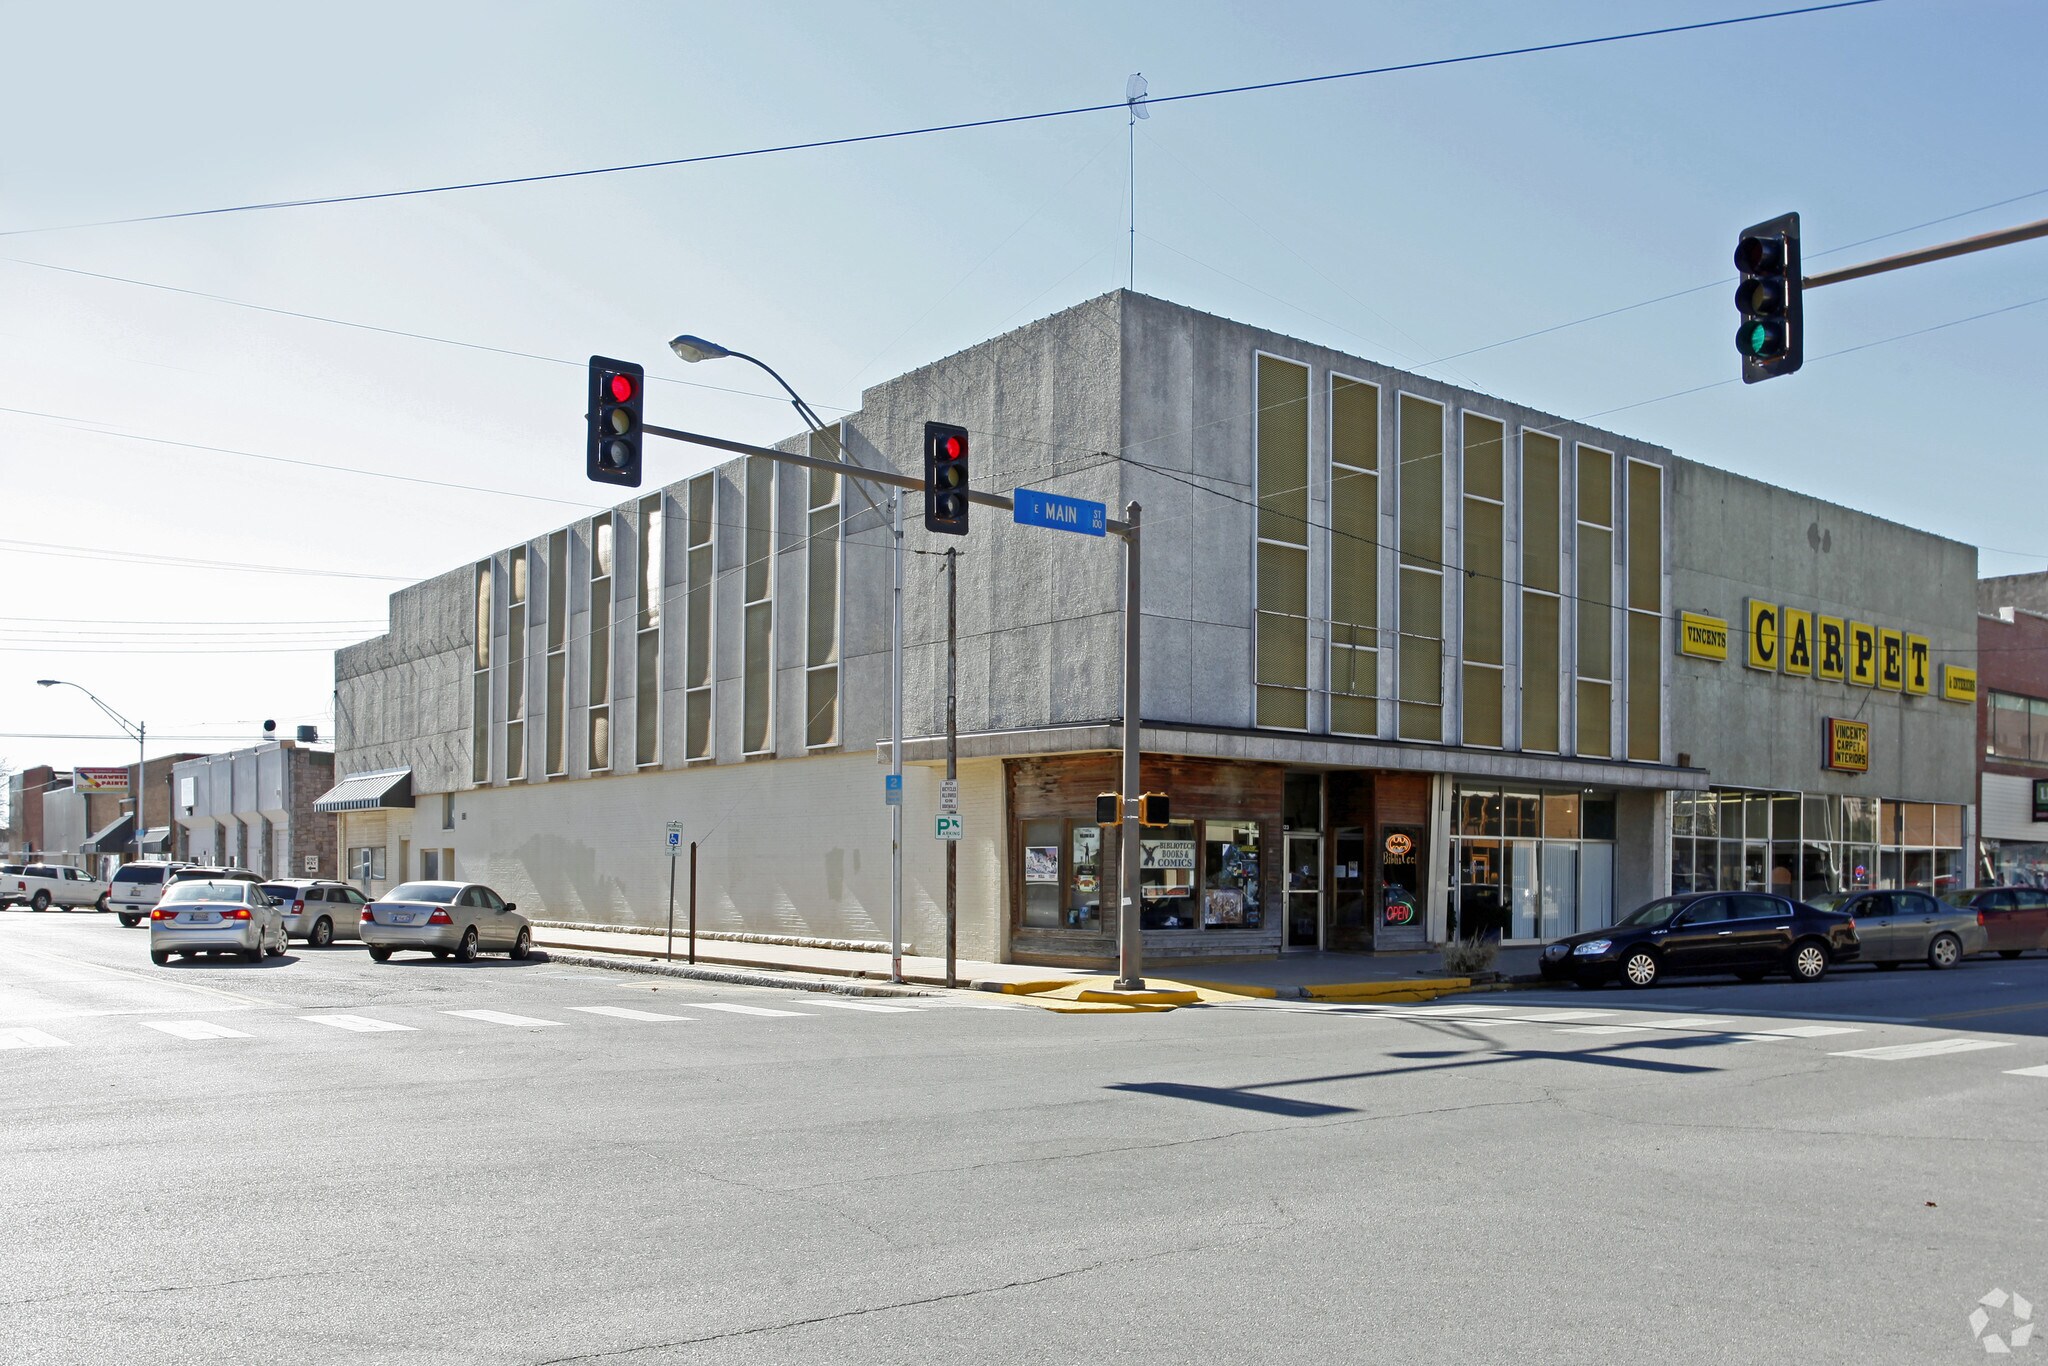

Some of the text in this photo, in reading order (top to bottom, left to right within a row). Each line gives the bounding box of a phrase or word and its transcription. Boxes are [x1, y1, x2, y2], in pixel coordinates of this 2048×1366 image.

[1034, 502, 1077, 524] E MAIN
[1093, 510, 1102, 519] ST
[1687, 626, 1726, 648] VINCENTS
[1756, 609, 1927, 687] CARPET
[1834, 724, 1867, 741] VINCENTS
[1836, 739, 1860, 753] CARPET
[1834, 751, 1866, 765] INTERIORS
[891, 778, 897, 787] 2
[1160, 842, 1196, 850] BIBLIOTECH
[1162, 850, 1184, 859] BOOKS
[1157, 859, 1193, 867] COMICS
[1386, 905, 1409, 921] OPEN
